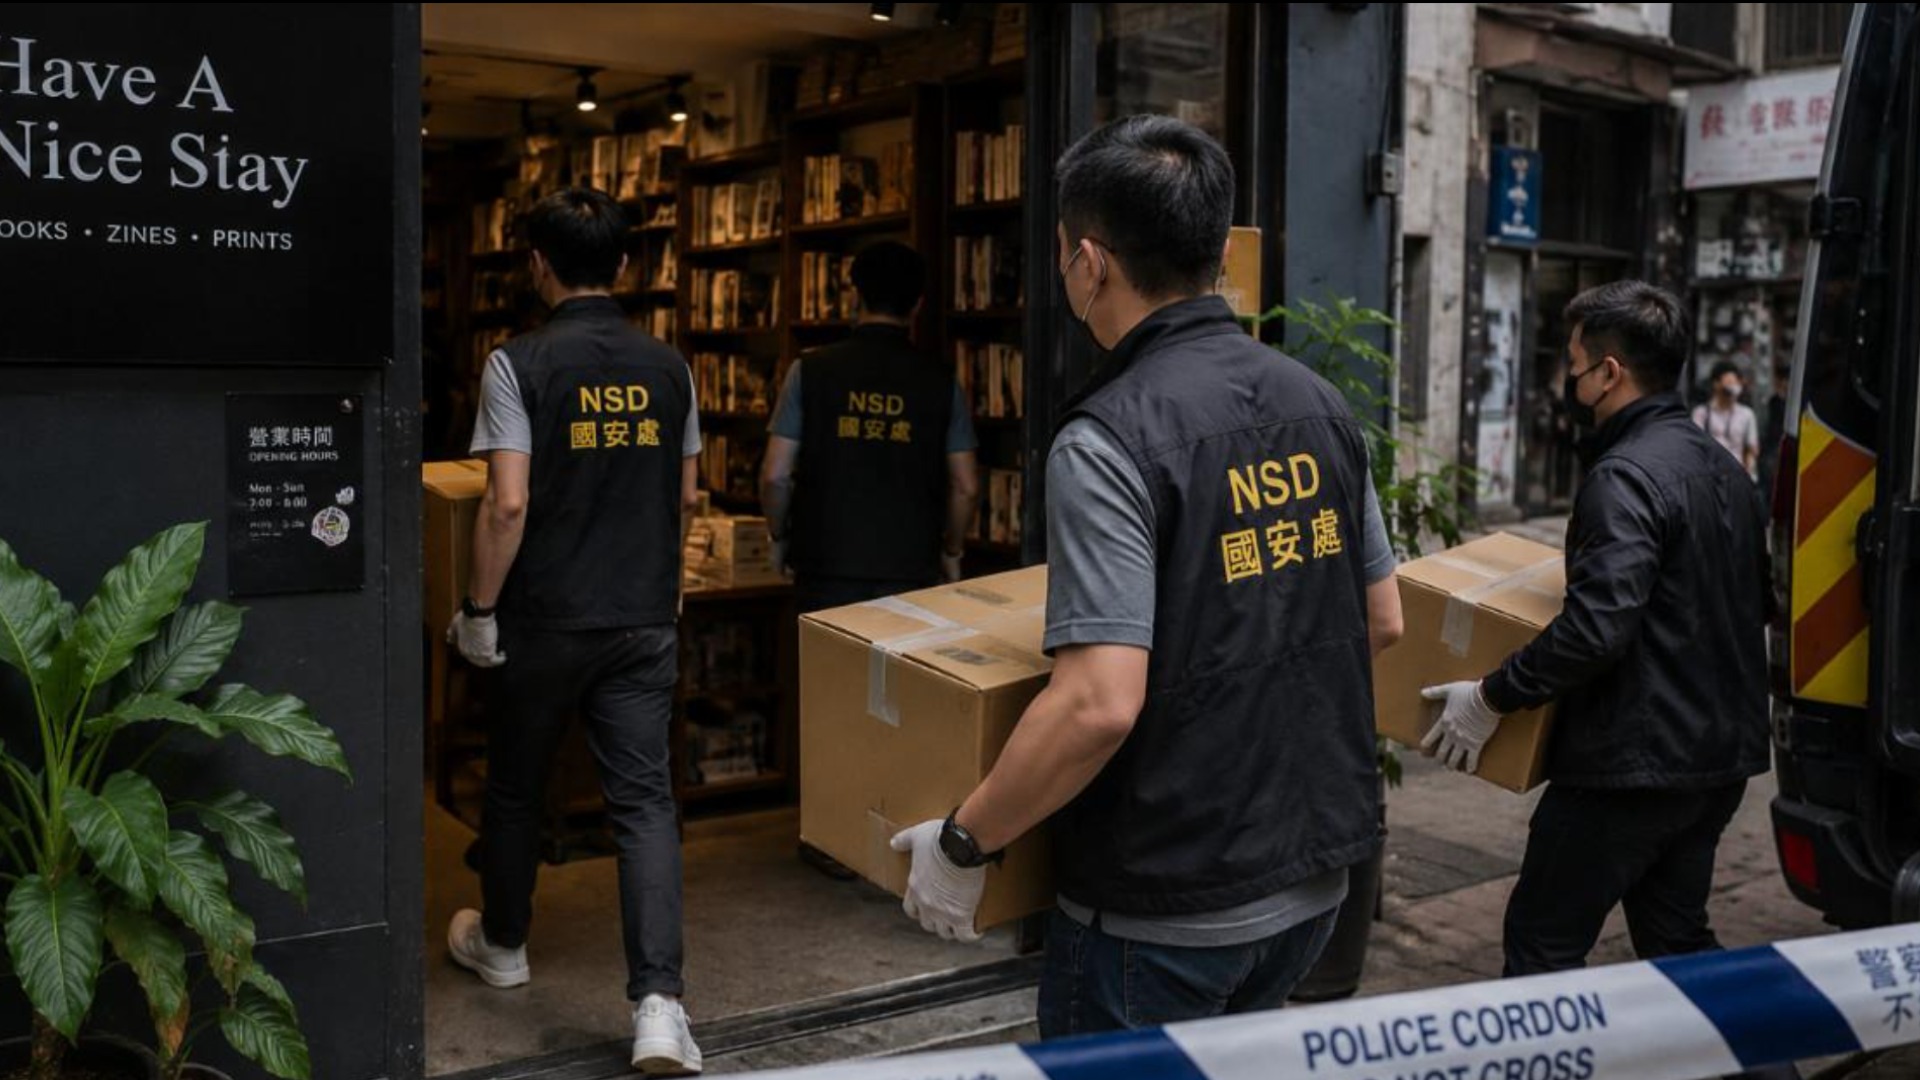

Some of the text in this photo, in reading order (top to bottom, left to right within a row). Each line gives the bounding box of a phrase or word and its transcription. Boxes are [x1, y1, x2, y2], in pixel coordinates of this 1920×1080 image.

[0, 37, 235, 113] Have A
[0, 120, 309, 209] Nice Stay
[107, 224, 177, 245] ZINES
[213, 229, 292, 250] PRINTS
[580, 385, 649, 413] NSD
[849, 391, 904, 416] NSD
[249, 426, 333, 447] 營業時間
[570, 418, 660, 449] 國安處
[837, 415, 911, 443] 國安處
[249, 451, 338, 462] OPENING HOURS
[249, 483, 272, 493] Mon
[1227, 452, 1320, 514] NSD
[1221, 508, 1342, 583] 國安處
[1303, 993, 1608, 1070] POLICE CORDON
